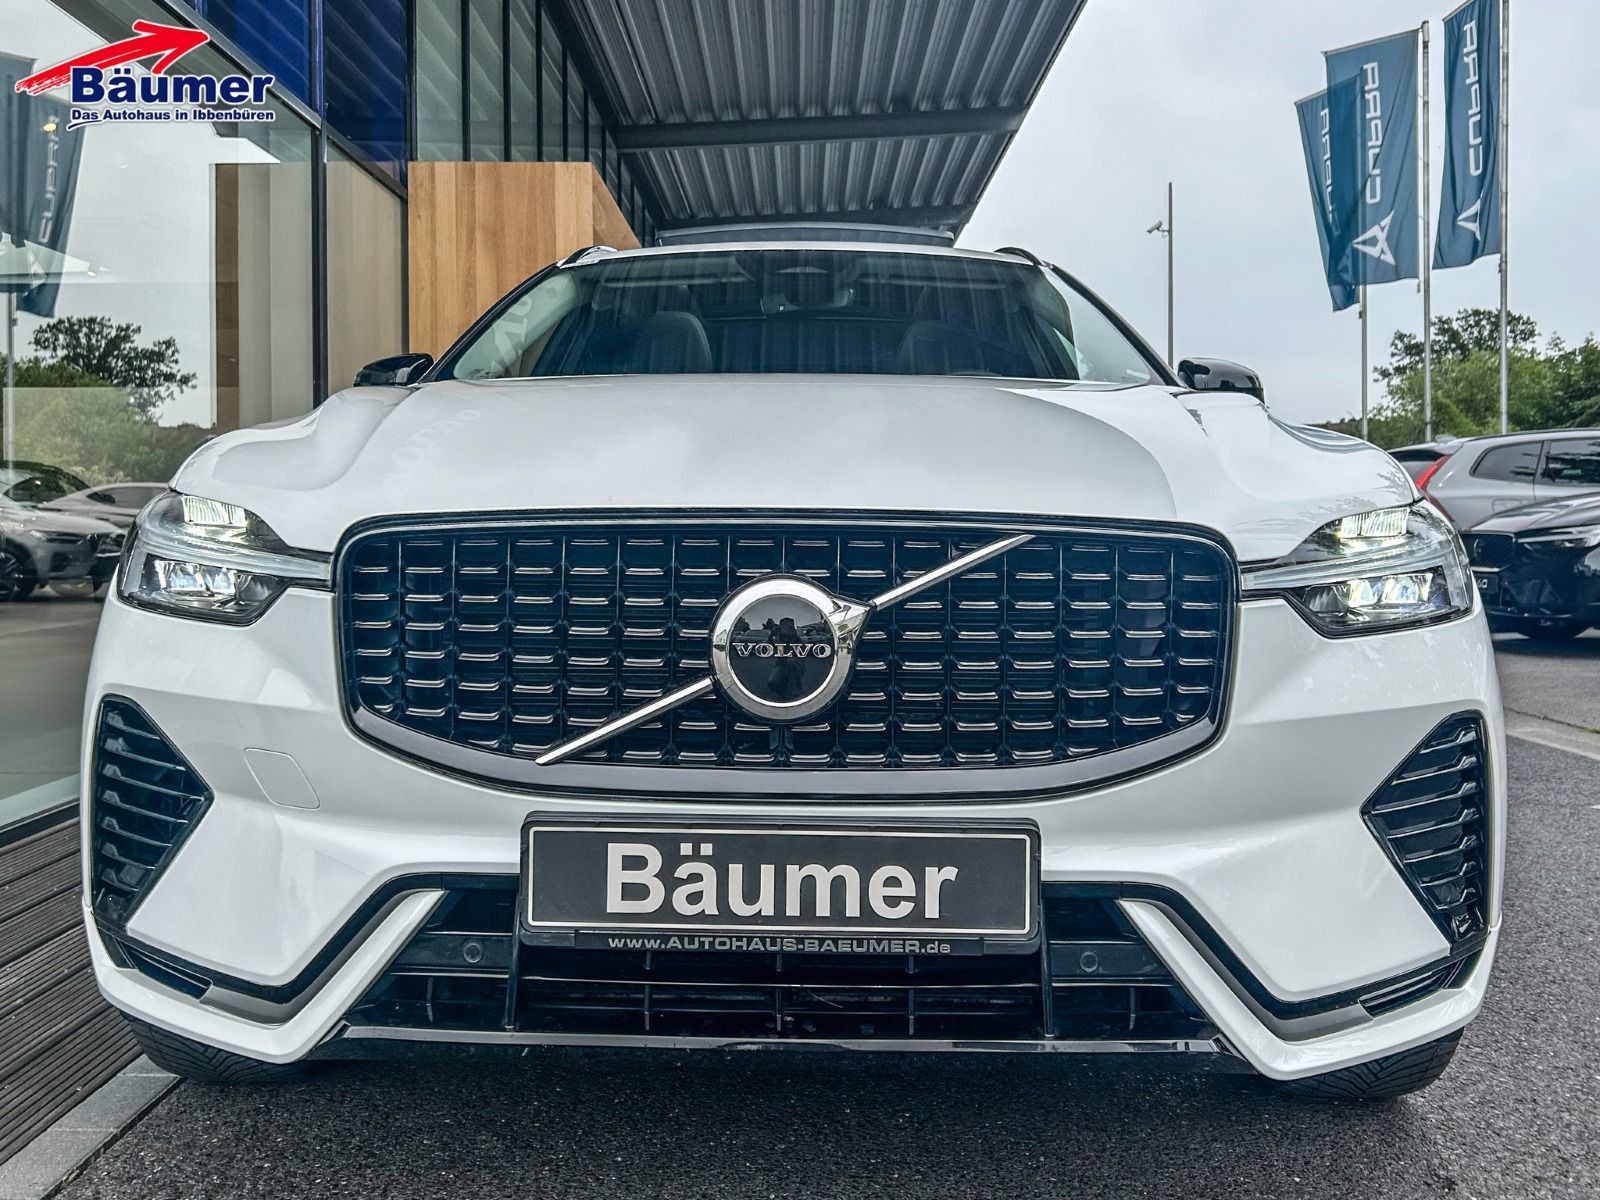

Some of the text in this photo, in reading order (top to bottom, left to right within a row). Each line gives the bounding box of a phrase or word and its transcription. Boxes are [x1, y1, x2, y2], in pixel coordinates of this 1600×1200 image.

[732, 642, 832, 658] VOLVO
[605, 842, 959, 919] Bäumer
[608, 936, 951, 954] www.AUTOHAUS-BAEUMER.de
